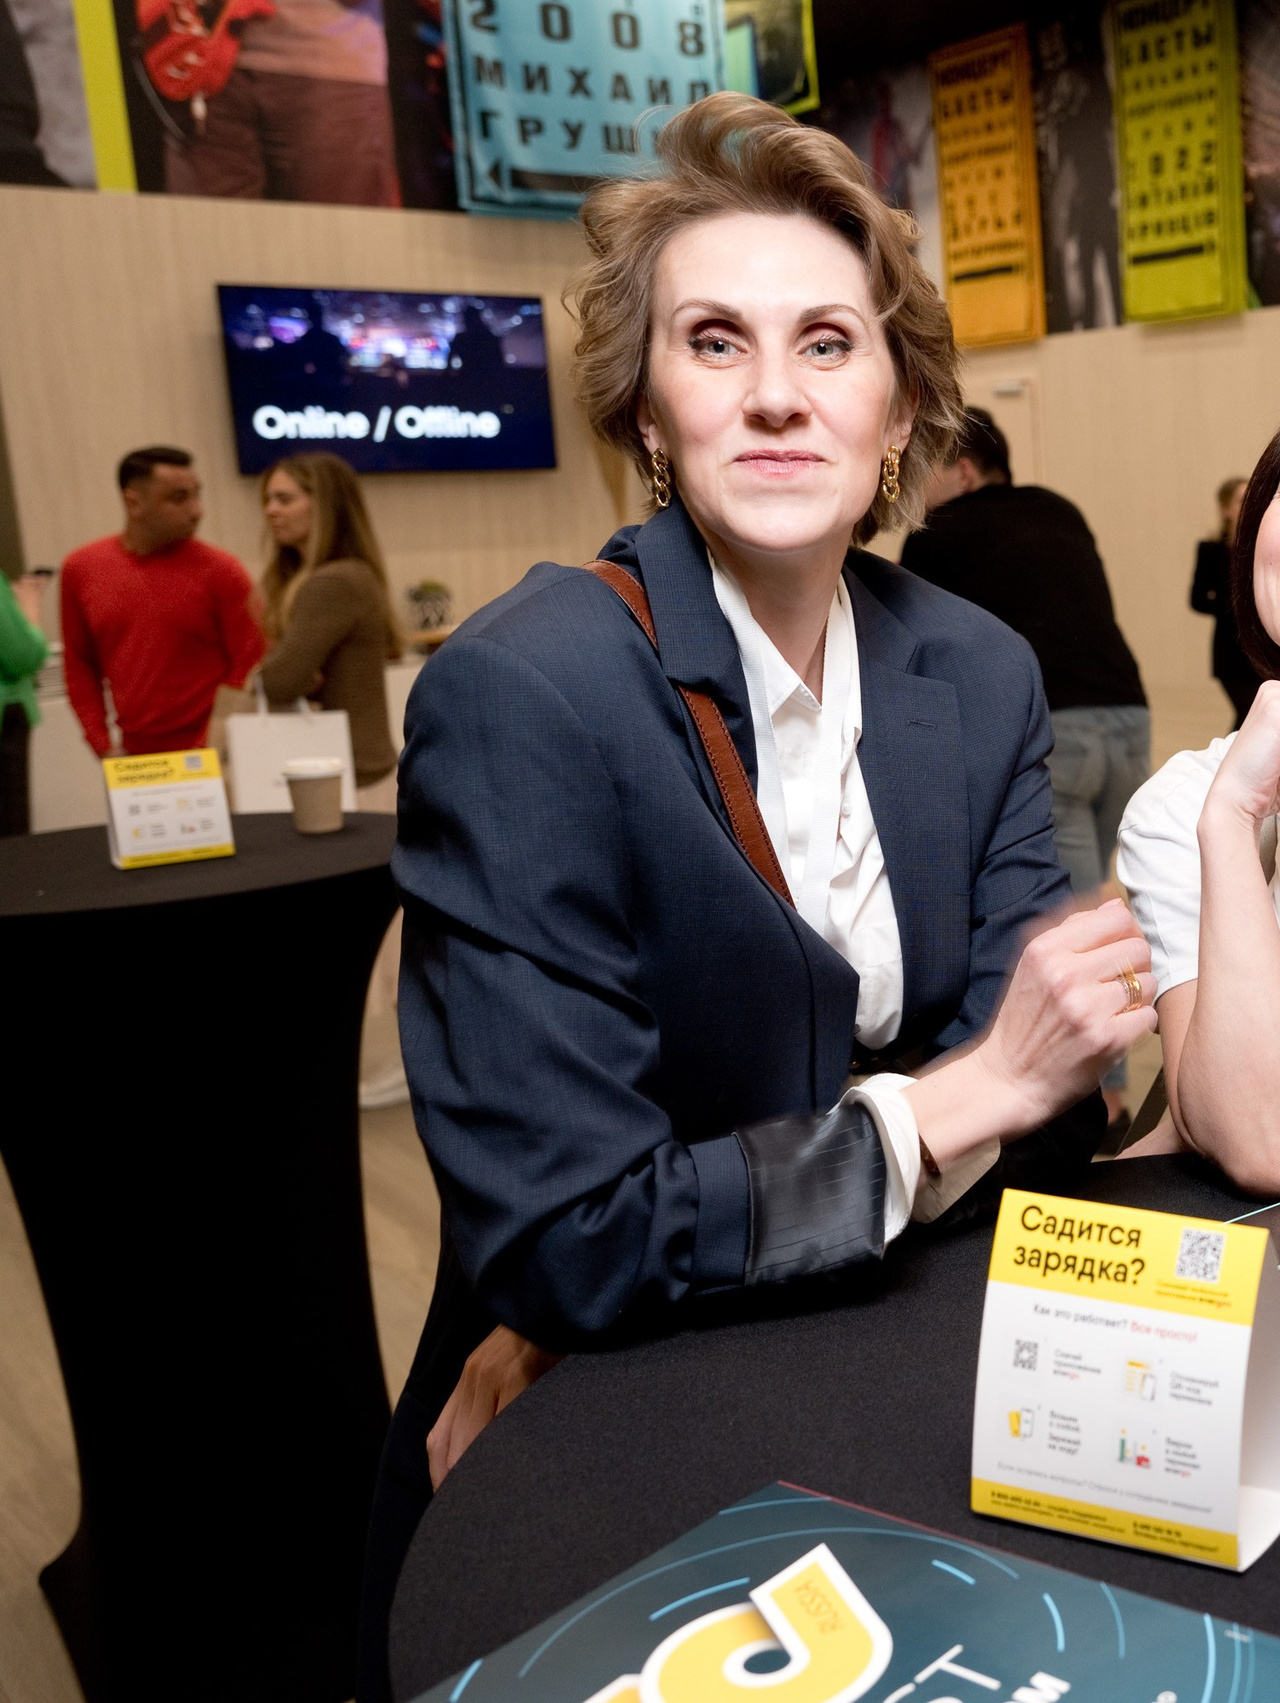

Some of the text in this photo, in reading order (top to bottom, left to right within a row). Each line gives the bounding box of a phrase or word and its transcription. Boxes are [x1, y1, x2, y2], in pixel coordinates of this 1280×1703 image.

[470, 0, 705, 57] 2008
[252, 404, 501, 443] Online / Offline
[1020, 1205, 1142, 1248] Садится
[1013, 1245, 1146, 1285] зарядка?
